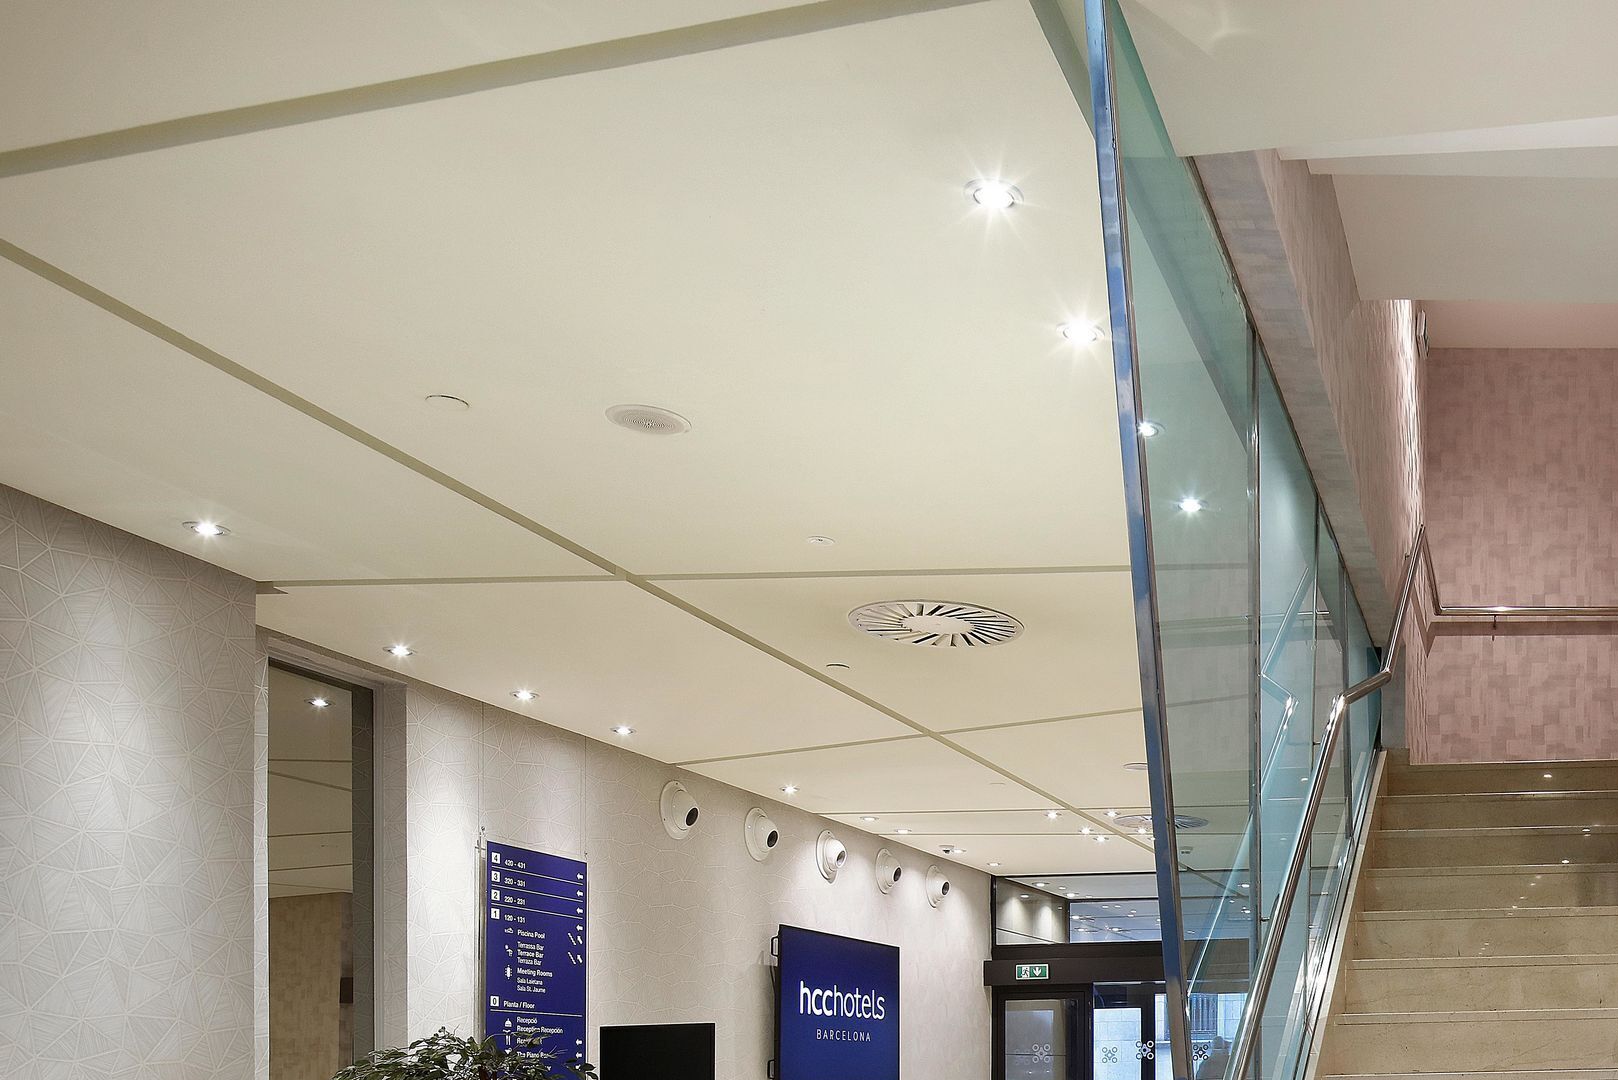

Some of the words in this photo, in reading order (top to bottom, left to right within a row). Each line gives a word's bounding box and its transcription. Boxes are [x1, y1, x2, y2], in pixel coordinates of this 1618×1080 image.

[517, 929, 534, 938] Piscina
[534, 931, 546, 939] Pool
[536, 943, 544, 951] Bar
[517, 949, 535, 958] Terrace
[536, 951, 544, 959] Bar
[517, 967, 536, 976] Meeting
[536, 970, 552, 978] Rooms
[503, 1000, 518, 1008] Planta
[799, 980, 885, 1020] hcchotels
[816, 1028, 871, 1042] BARCELONA
